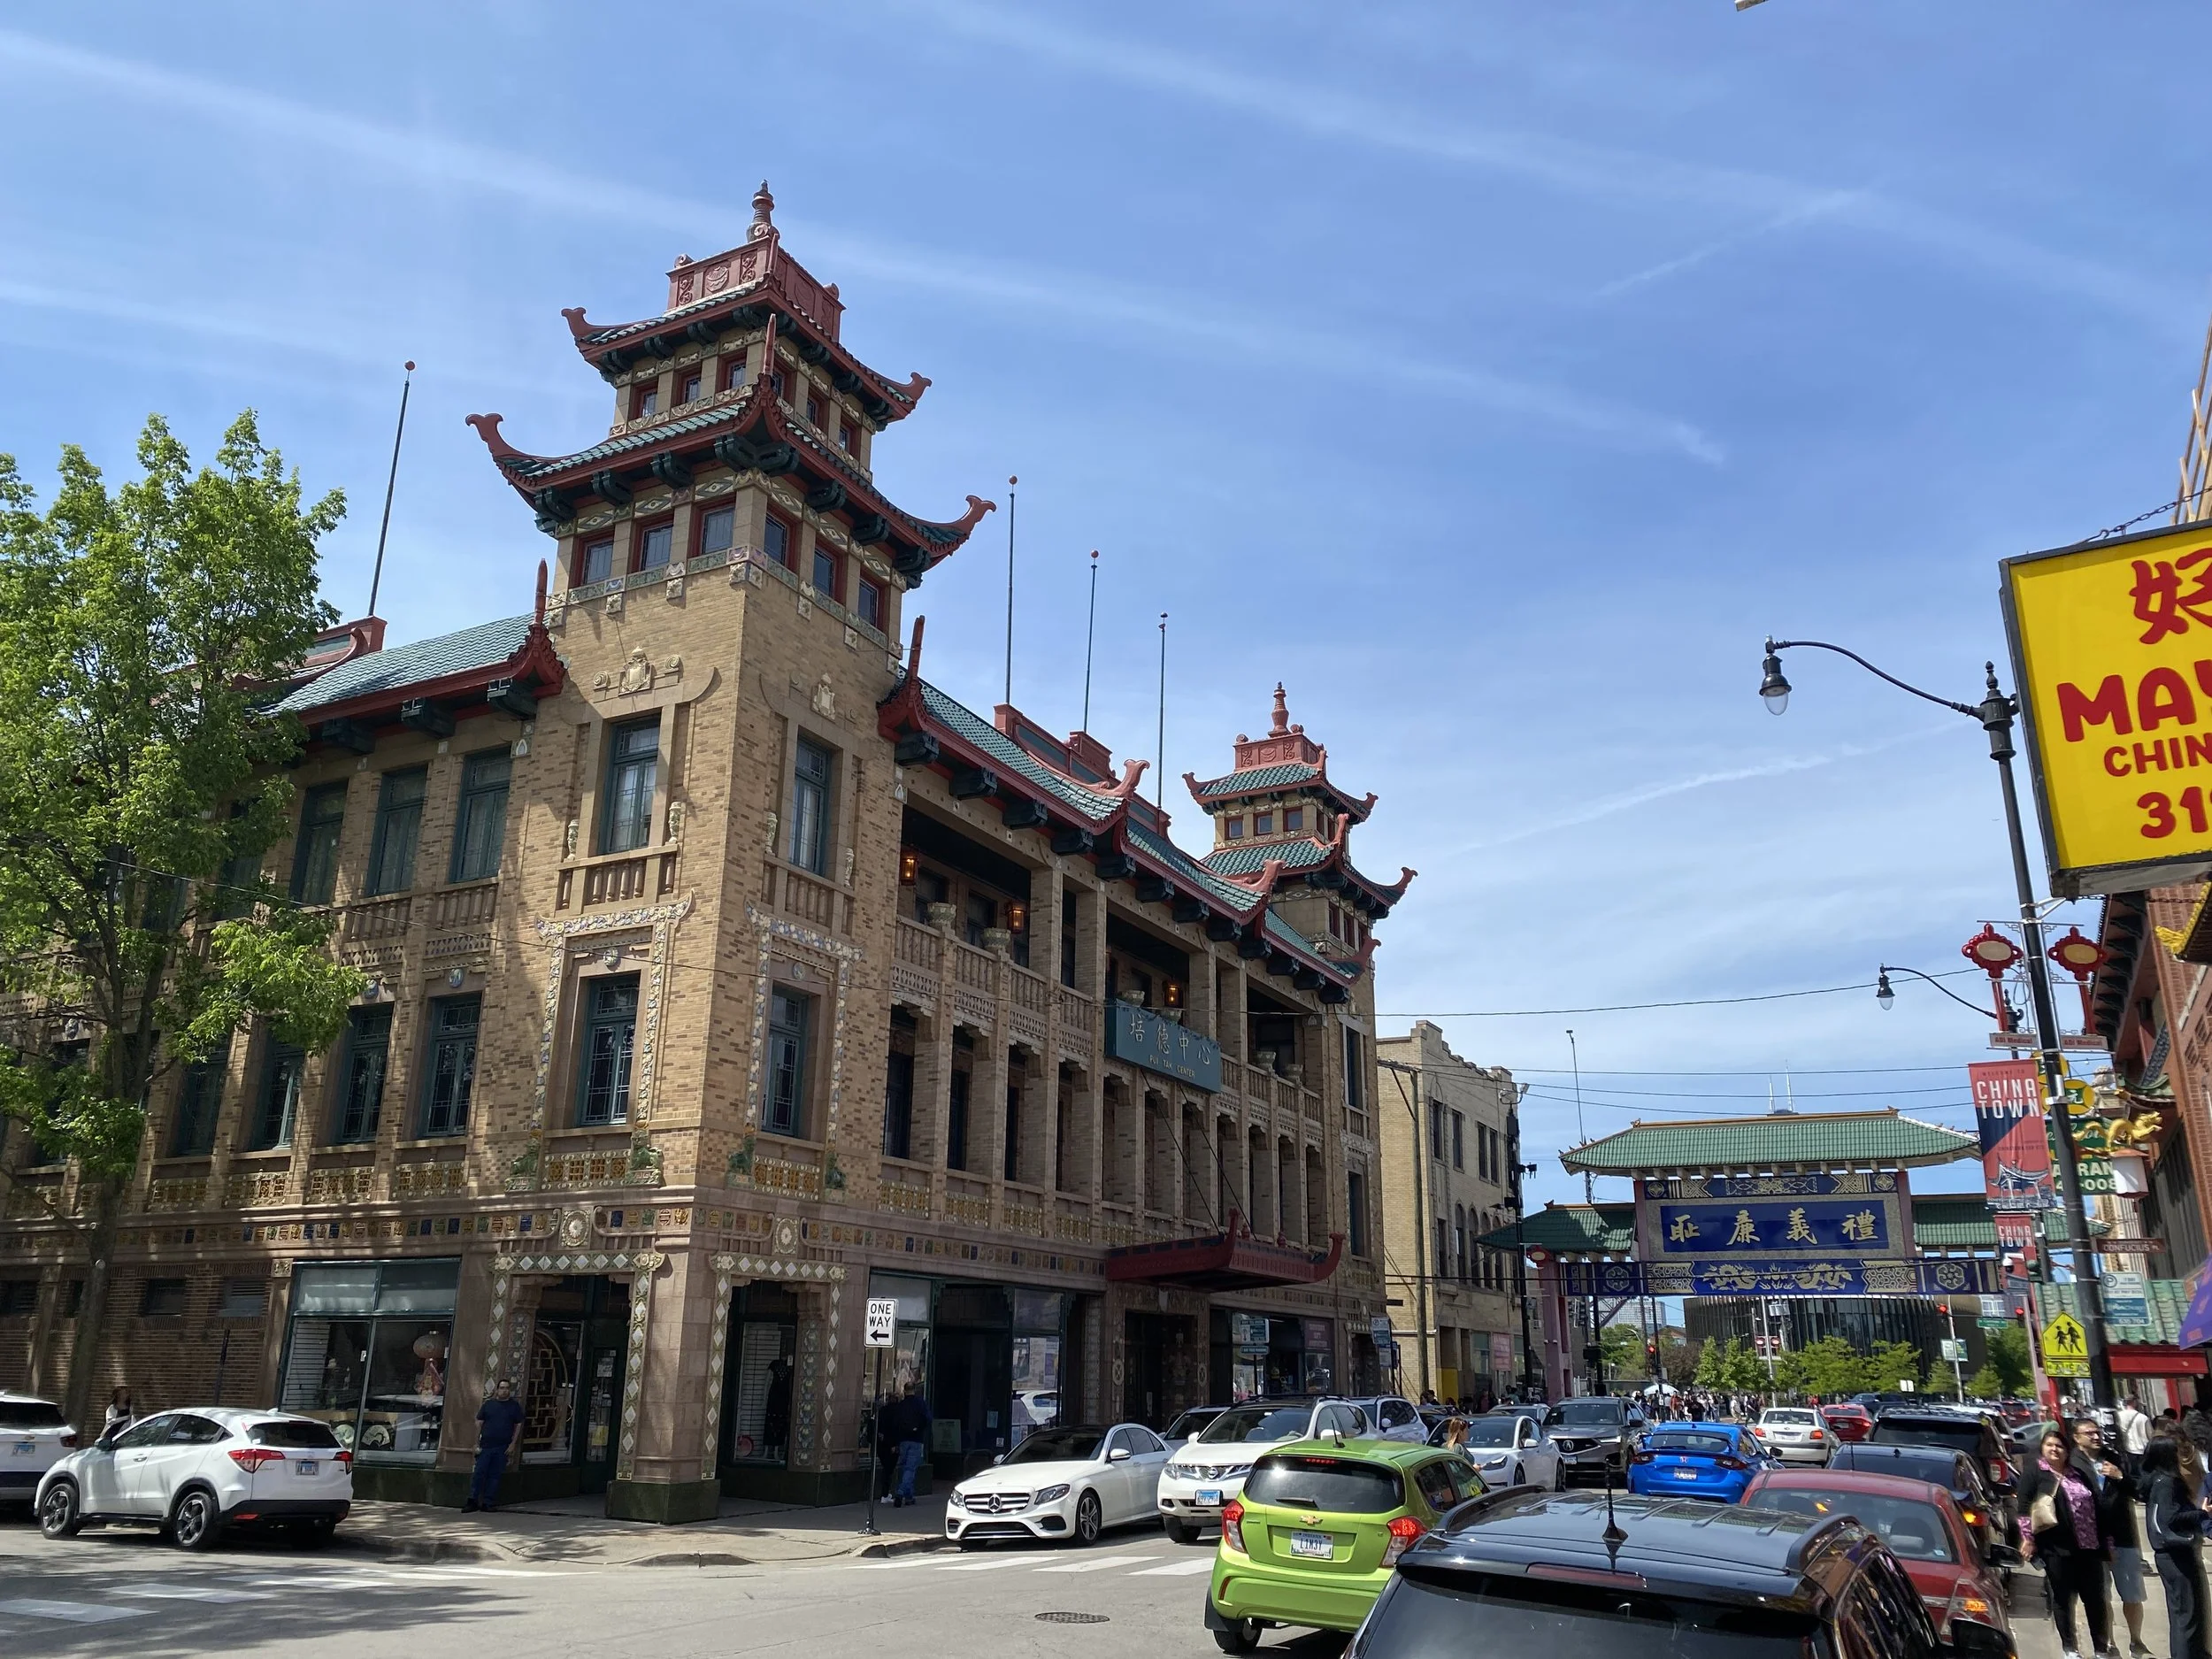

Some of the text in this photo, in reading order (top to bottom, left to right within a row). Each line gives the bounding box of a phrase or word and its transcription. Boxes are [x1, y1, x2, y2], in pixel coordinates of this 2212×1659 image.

[1130, 1013, 1211, 1065] 培德中心
[1149, 1054, 1195, 1078] PUI TAK CENTER
[1977, 1078, 2037, 1100] CHINA
[1978, 1098, 2040, 1119] TOWN
[1998, 1225, 2032, 1237] CHINA
[1999, 1236, 2033, 1248] TOWN
[2103, 1243, 2150, 1252] CONFUCIUS
[870, 1303, 892, 1314] ONE
[869, 1316, 891, 1327] WAY
